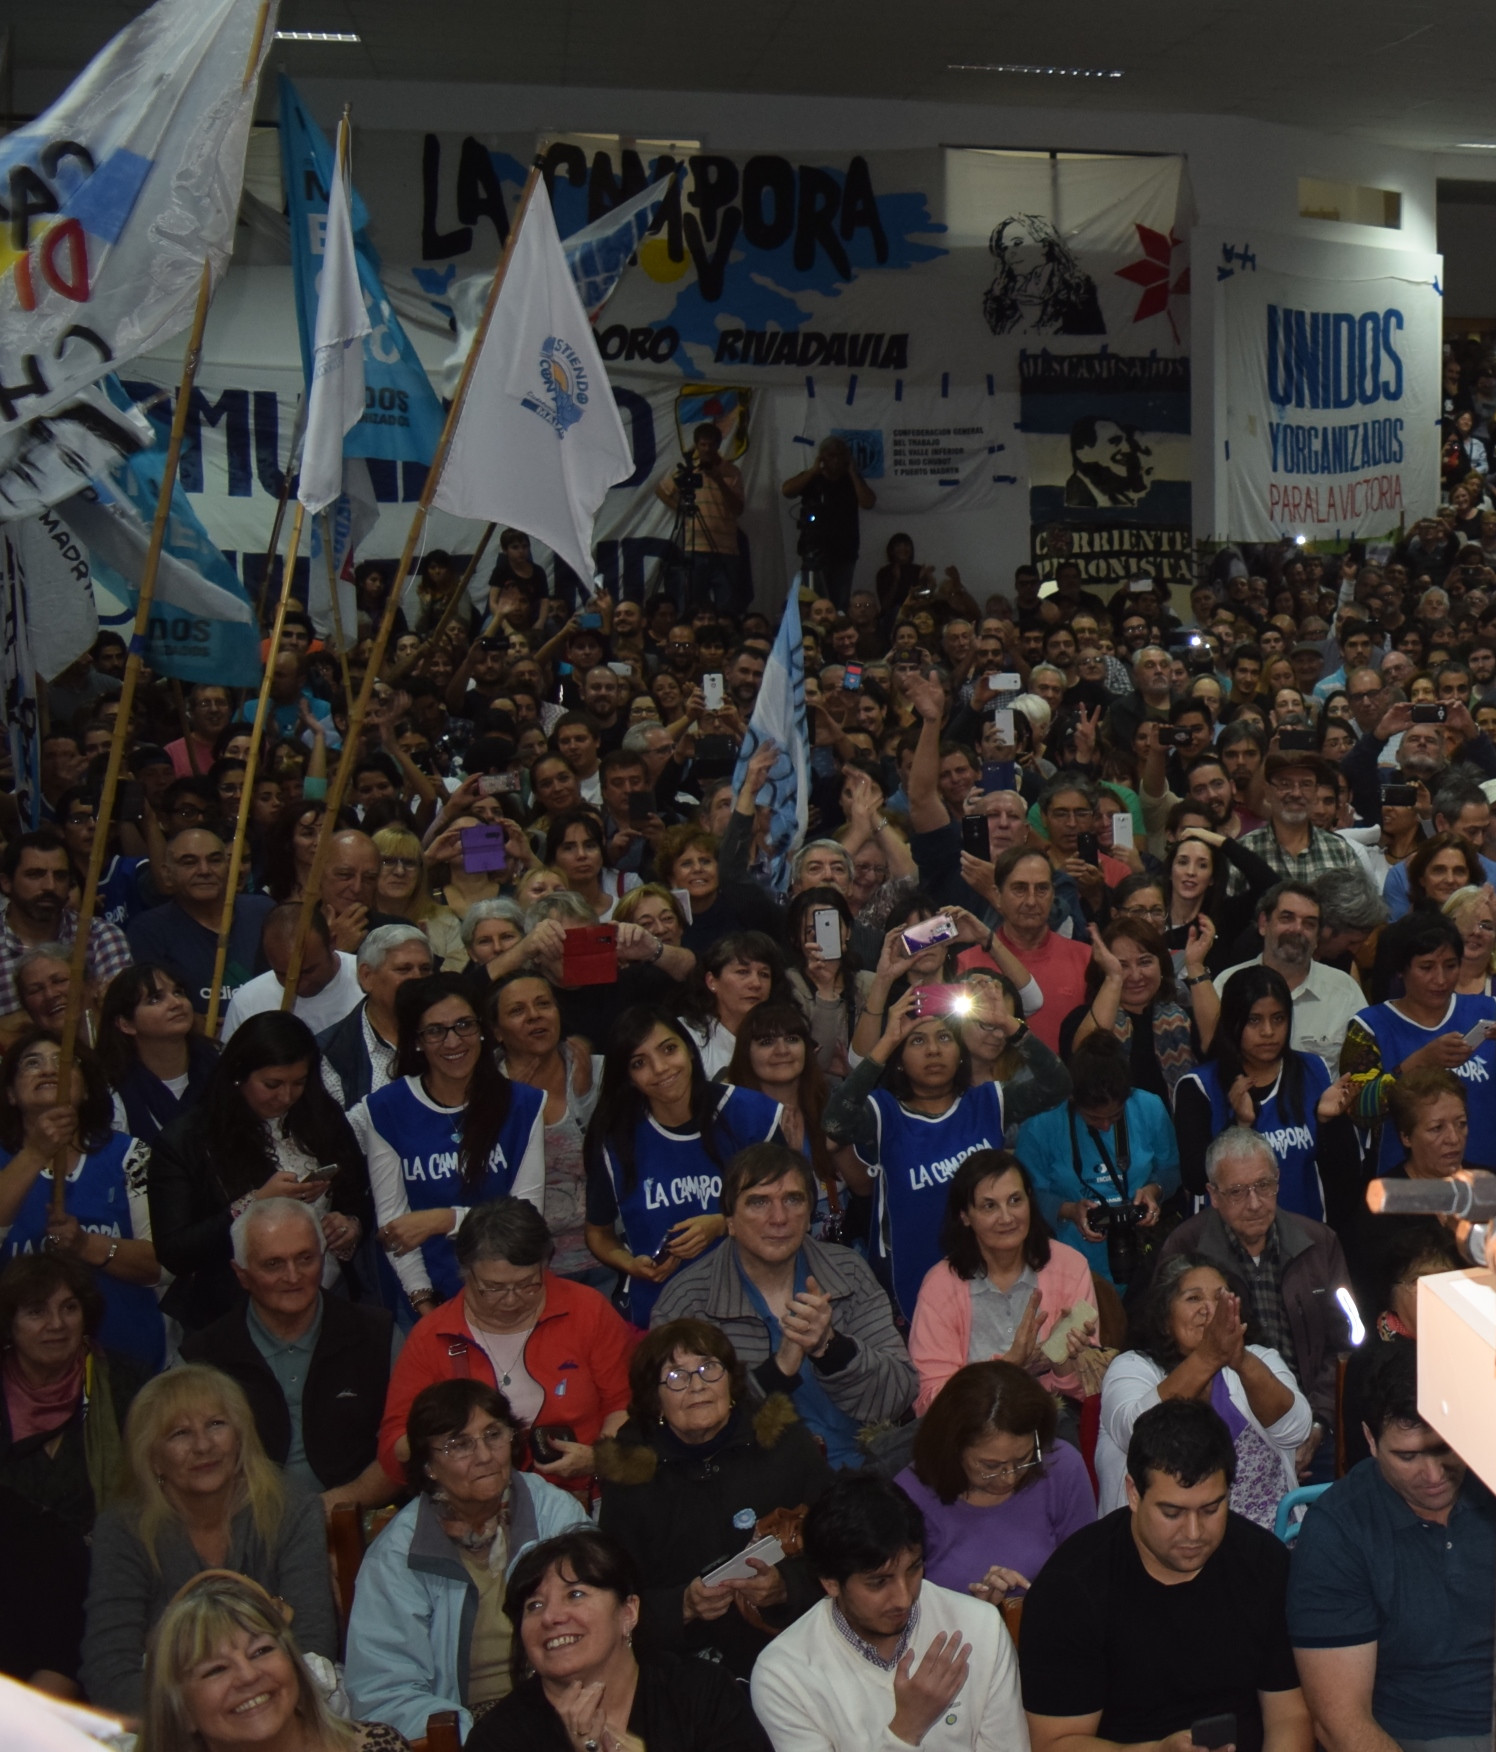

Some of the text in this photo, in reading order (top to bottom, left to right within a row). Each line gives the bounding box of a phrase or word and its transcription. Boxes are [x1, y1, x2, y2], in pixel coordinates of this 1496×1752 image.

[422, 132, 512, 260] LA
[714, 327, 910, 369] RIVADAVIA
[1267, 304, 1404, 409] UNIDOS
[403, 1155, 427, 1182] LA
[909, 1164, 935, 1191] LA
[645, 1181, 670, 1211] LA
